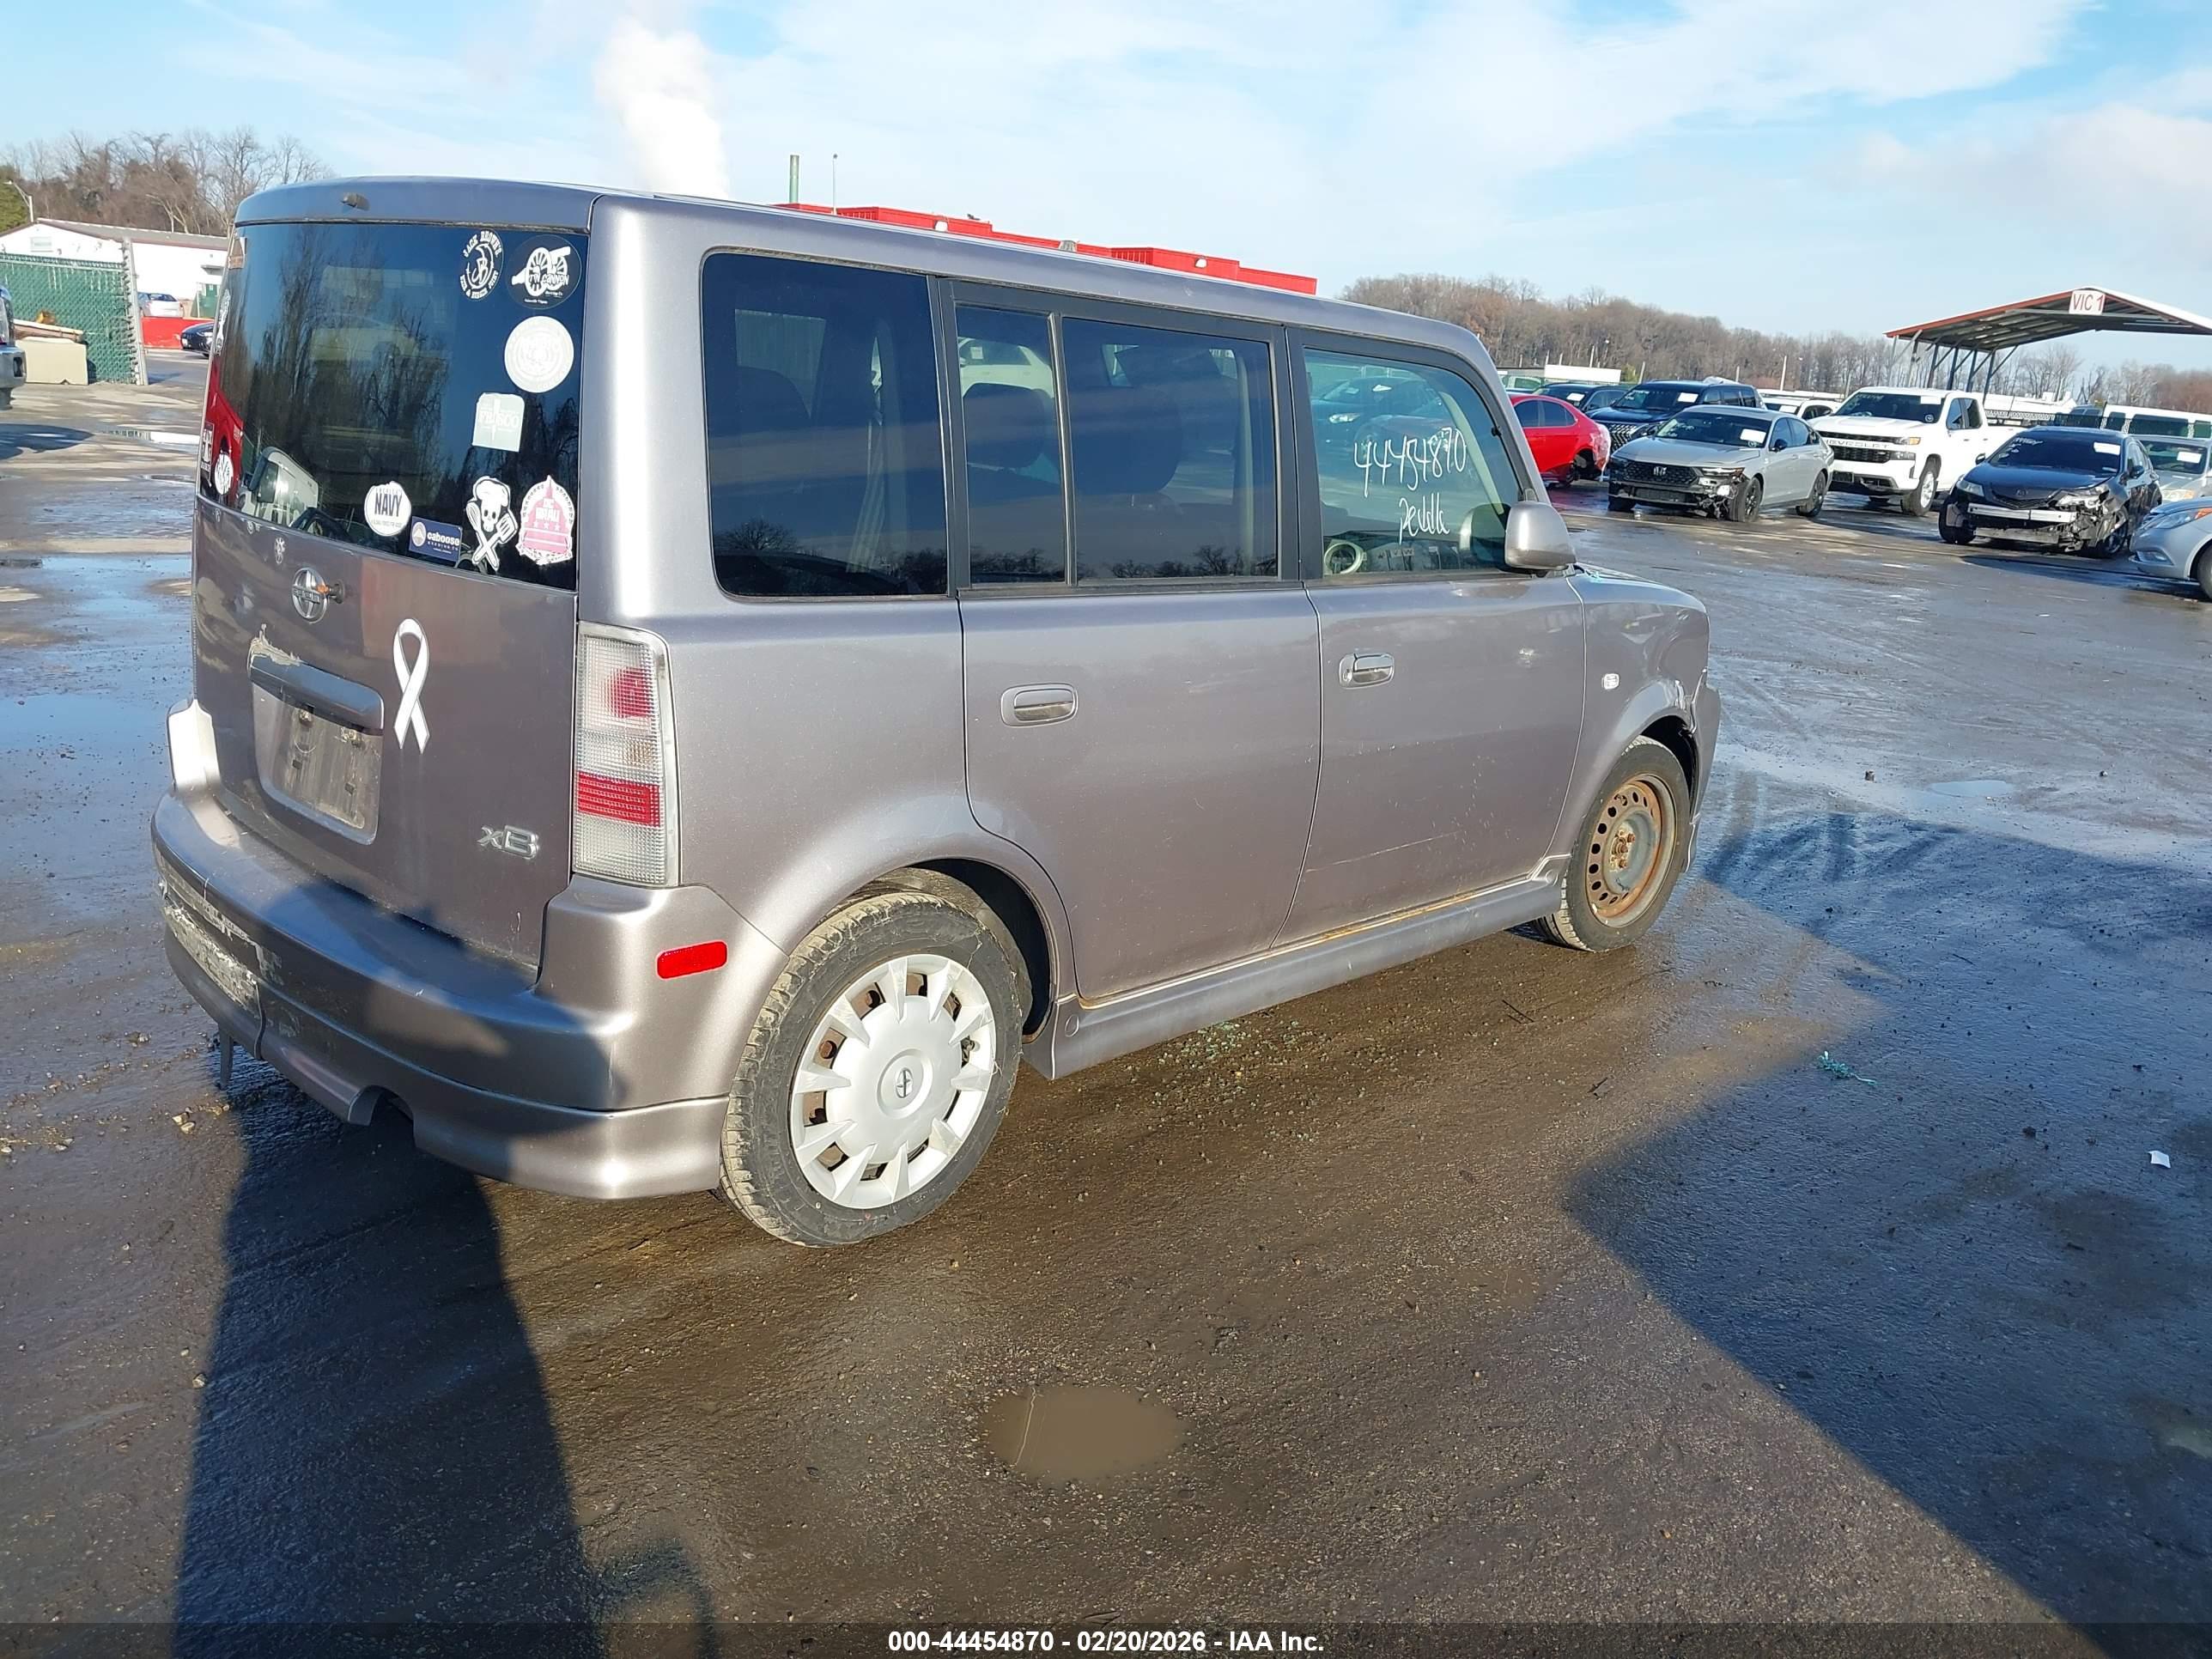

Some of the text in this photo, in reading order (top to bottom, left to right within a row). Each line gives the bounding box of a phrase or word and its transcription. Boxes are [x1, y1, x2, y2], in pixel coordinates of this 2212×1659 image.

[2074, 294, 2104, 312] VIC 1
[1354, 427, 1468, 498] 44454870
[374, 493, 402, 517] NAVY
[427, 532, 460, 546] caboose
[477, 824, 539, 860] xB
